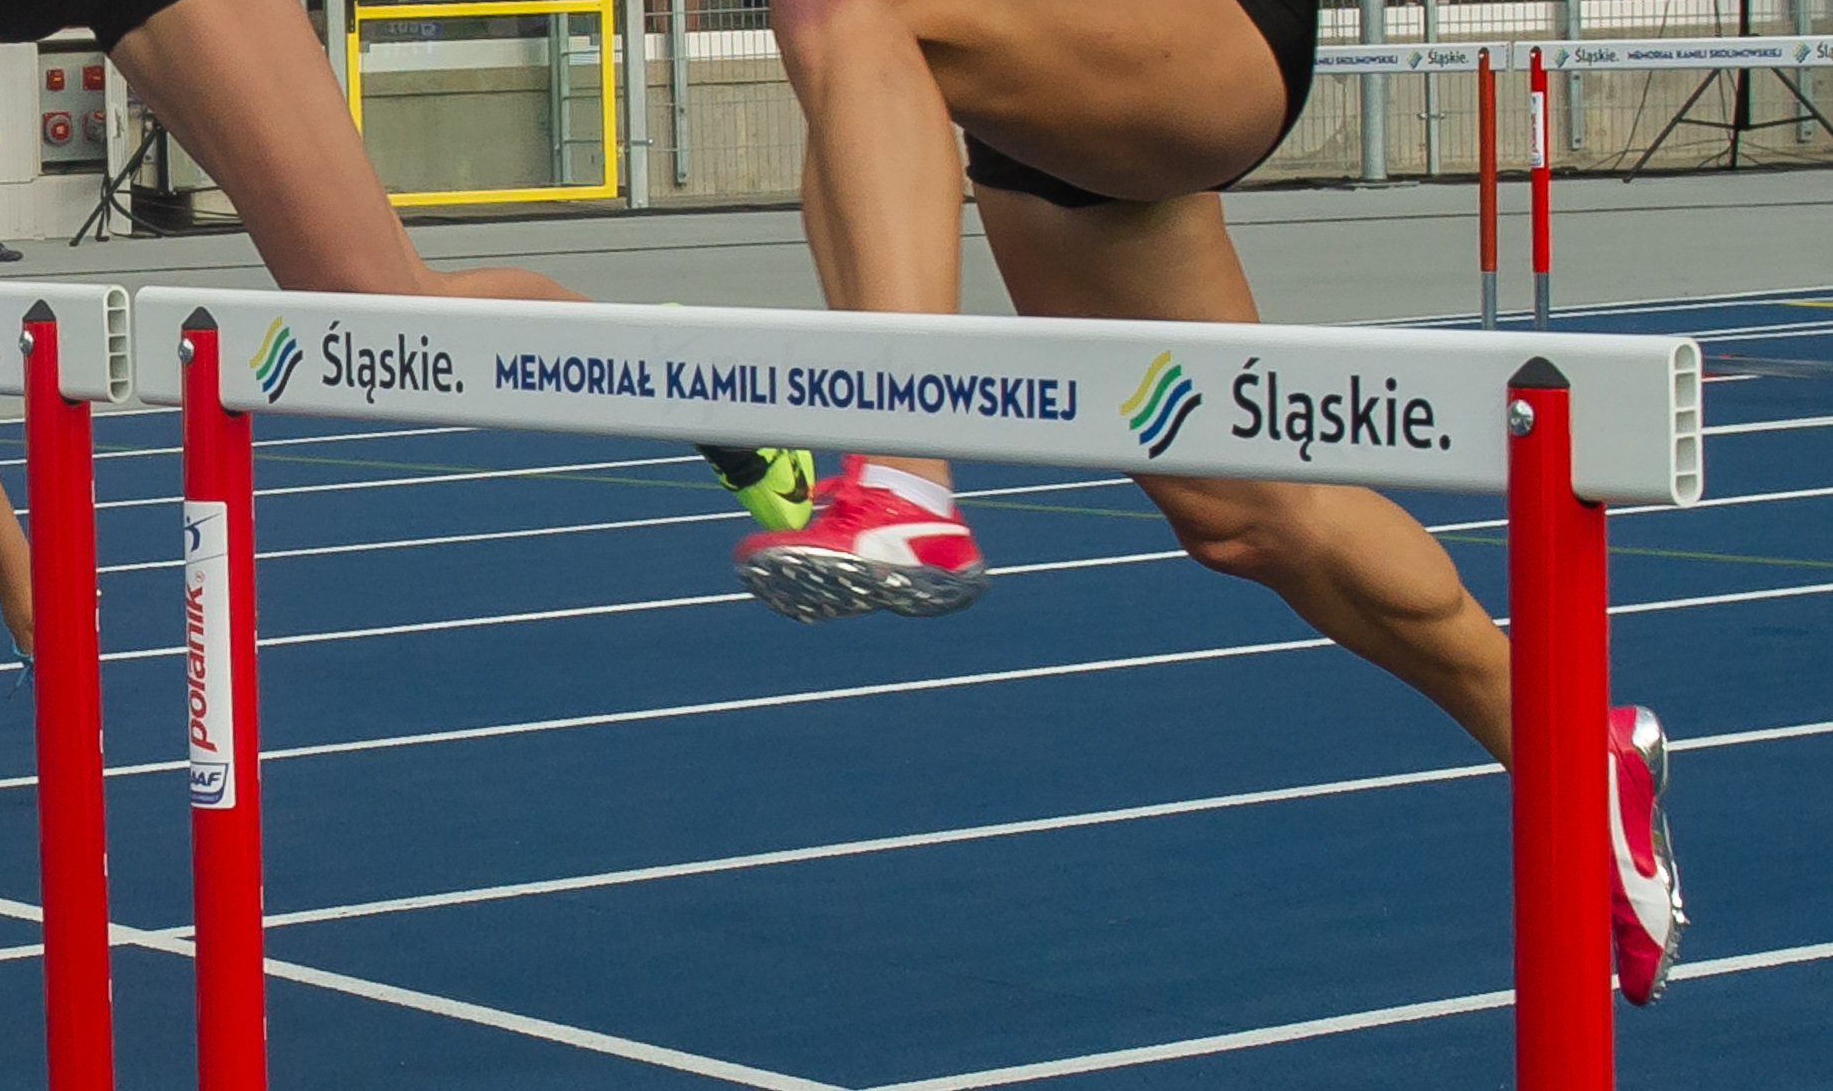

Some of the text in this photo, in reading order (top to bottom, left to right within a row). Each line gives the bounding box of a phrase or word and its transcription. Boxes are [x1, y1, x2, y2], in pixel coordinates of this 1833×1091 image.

[322, 320, 1452, 462] Śląskie. MEMORIAŁ KAMILI SKOLIMOWSKIEJ Śląskie.
[185, 583, 218, 753] polanik
